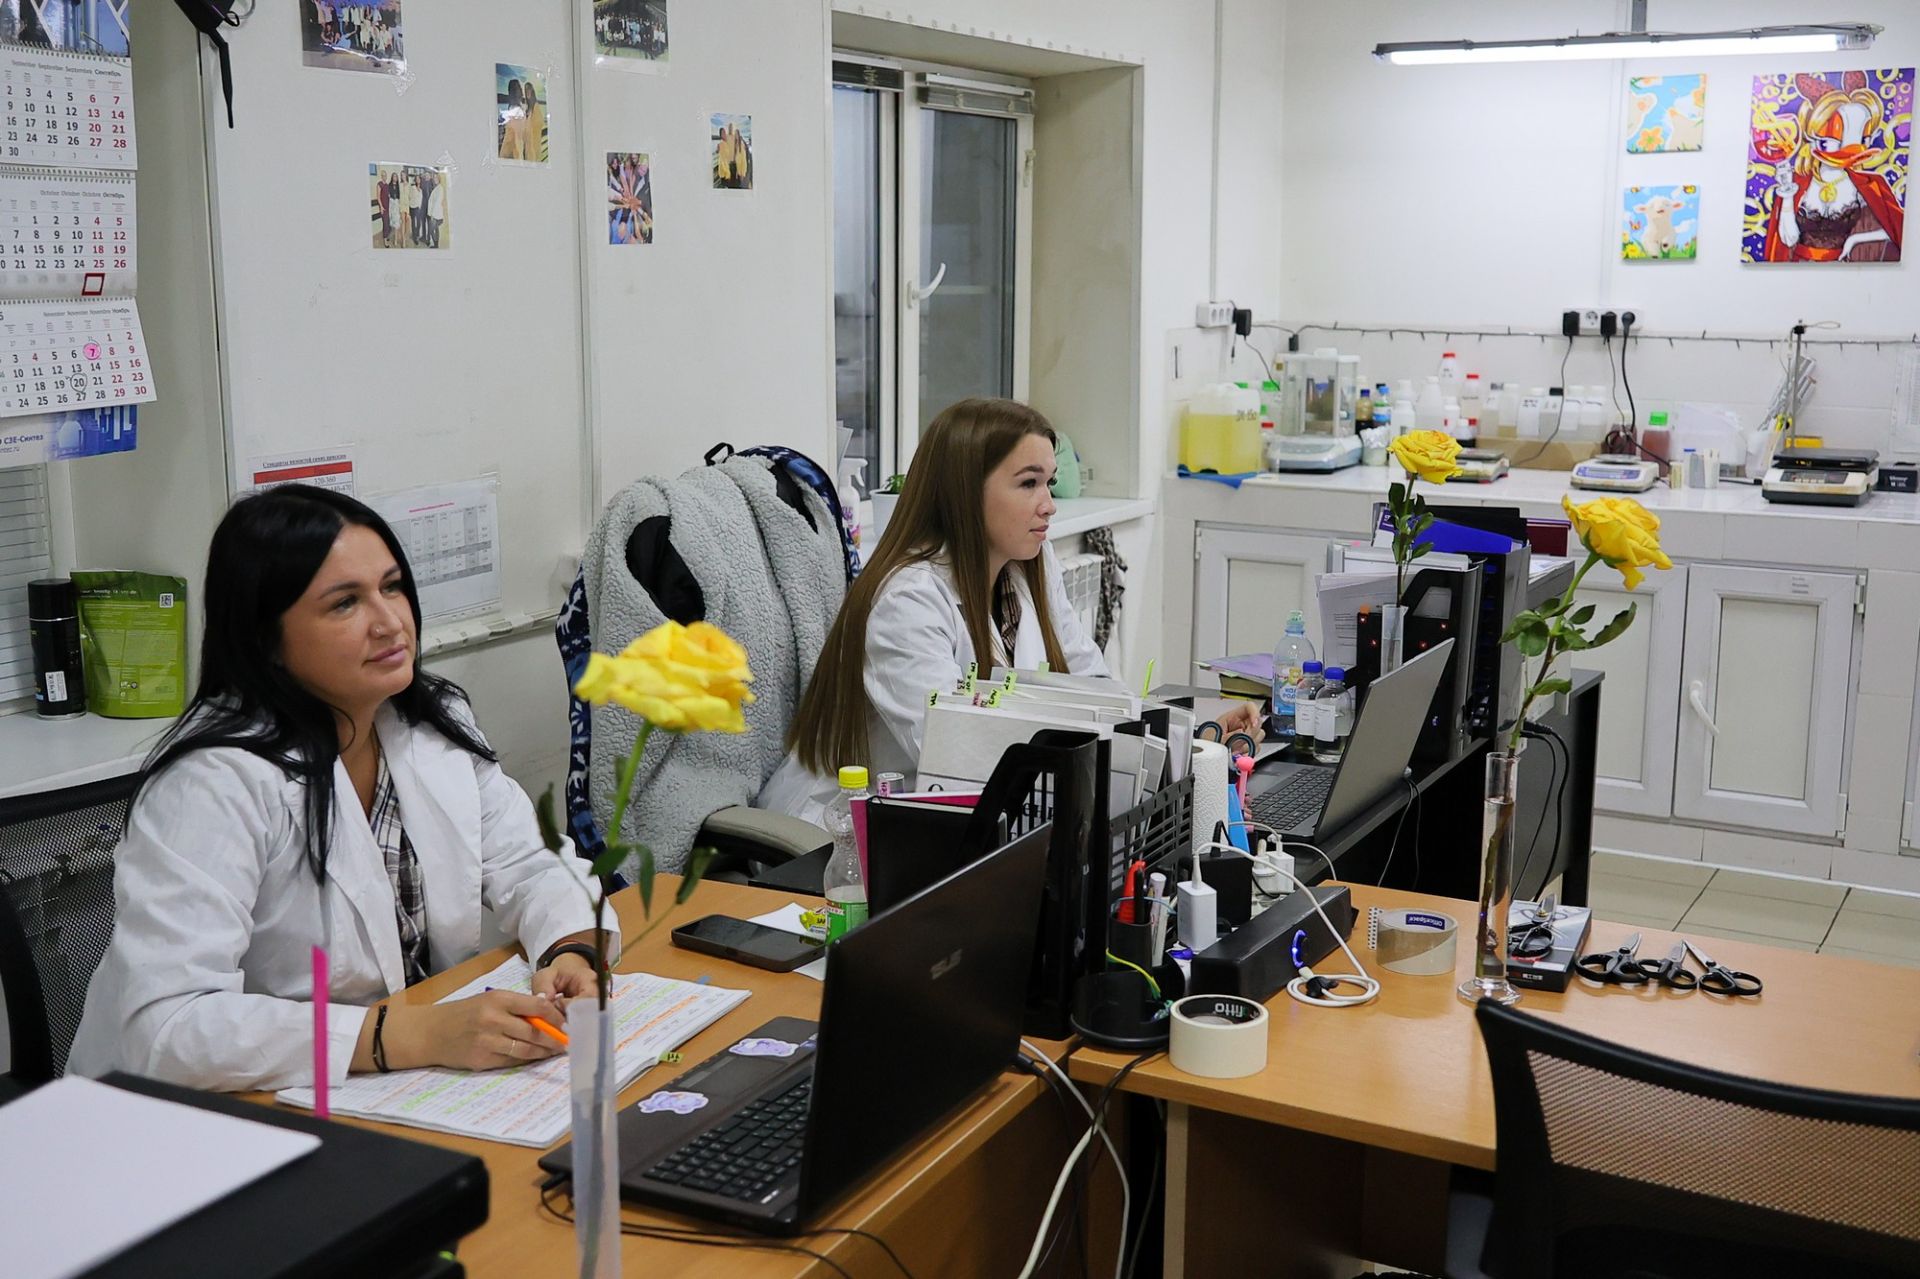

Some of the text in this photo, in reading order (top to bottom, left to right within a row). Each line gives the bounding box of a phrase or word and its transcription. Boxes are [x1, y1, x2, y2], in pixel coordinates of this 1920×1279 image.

[7, 85, 120, 105] 2 3 4 5 6 7
[7, 101, 125, 120] 9 10 11 12 13 14
[7, 117, 126, 134] 16 17 18 19 20 21
[7, 131, 127, 148] 23 24 25 26 27 28
[8, 147, 19, 157] 30
[32, 216, 38, 224] 1
[53, 216, 60, 225] 2
[73, 216, 80, 225] 3
[94, 217, 100, 226] 4
[116, 217, 123, 226] 5
[13, 230, 126, 240] 7 8 9 10 11 12
[0, 245, 126, 254] 3 14 15 16 17 18 19
[0, 259, 127, 269] 0 21 22 23 24 25 26
[0, 312, 4, 321] 5
[107, 333, 112, 342] 1
[126, 331, 133, 340] 2
[13, 345, 135, 363] 3 4 5 6 7 8 9
[13, 369, 24, 378] 10
[32, 368, 43, 377] 11
[52, 366, 63, 375] 12
[71, 364, 83, 373] 13
[90, 363, 101, 371] 14
[109, 361, 120, 370] 15
[129, 359, 141, 368] 16
[16, 384, 26, 393] 17
[34, 382, 46, 391] 18
[54, 380, 65, 389] 19
[73, 378, 85, 388] 20
[93, 376, 103, 385] 21
[111, 374, 123, 384] 22
[132, 373, 144, 382] 23
[19, 399, 30, 408] 24
[37, 396, 49, 406] 25
[57, 394, 68, 404] 26
[76, 392, 87, 401] 27
[95, 390, 106, 399] 28
[114, 388, 126, 398] 29
[134, 386, 147, 395] 30
[1408, 916, 1443, 927] OfficeSpace
